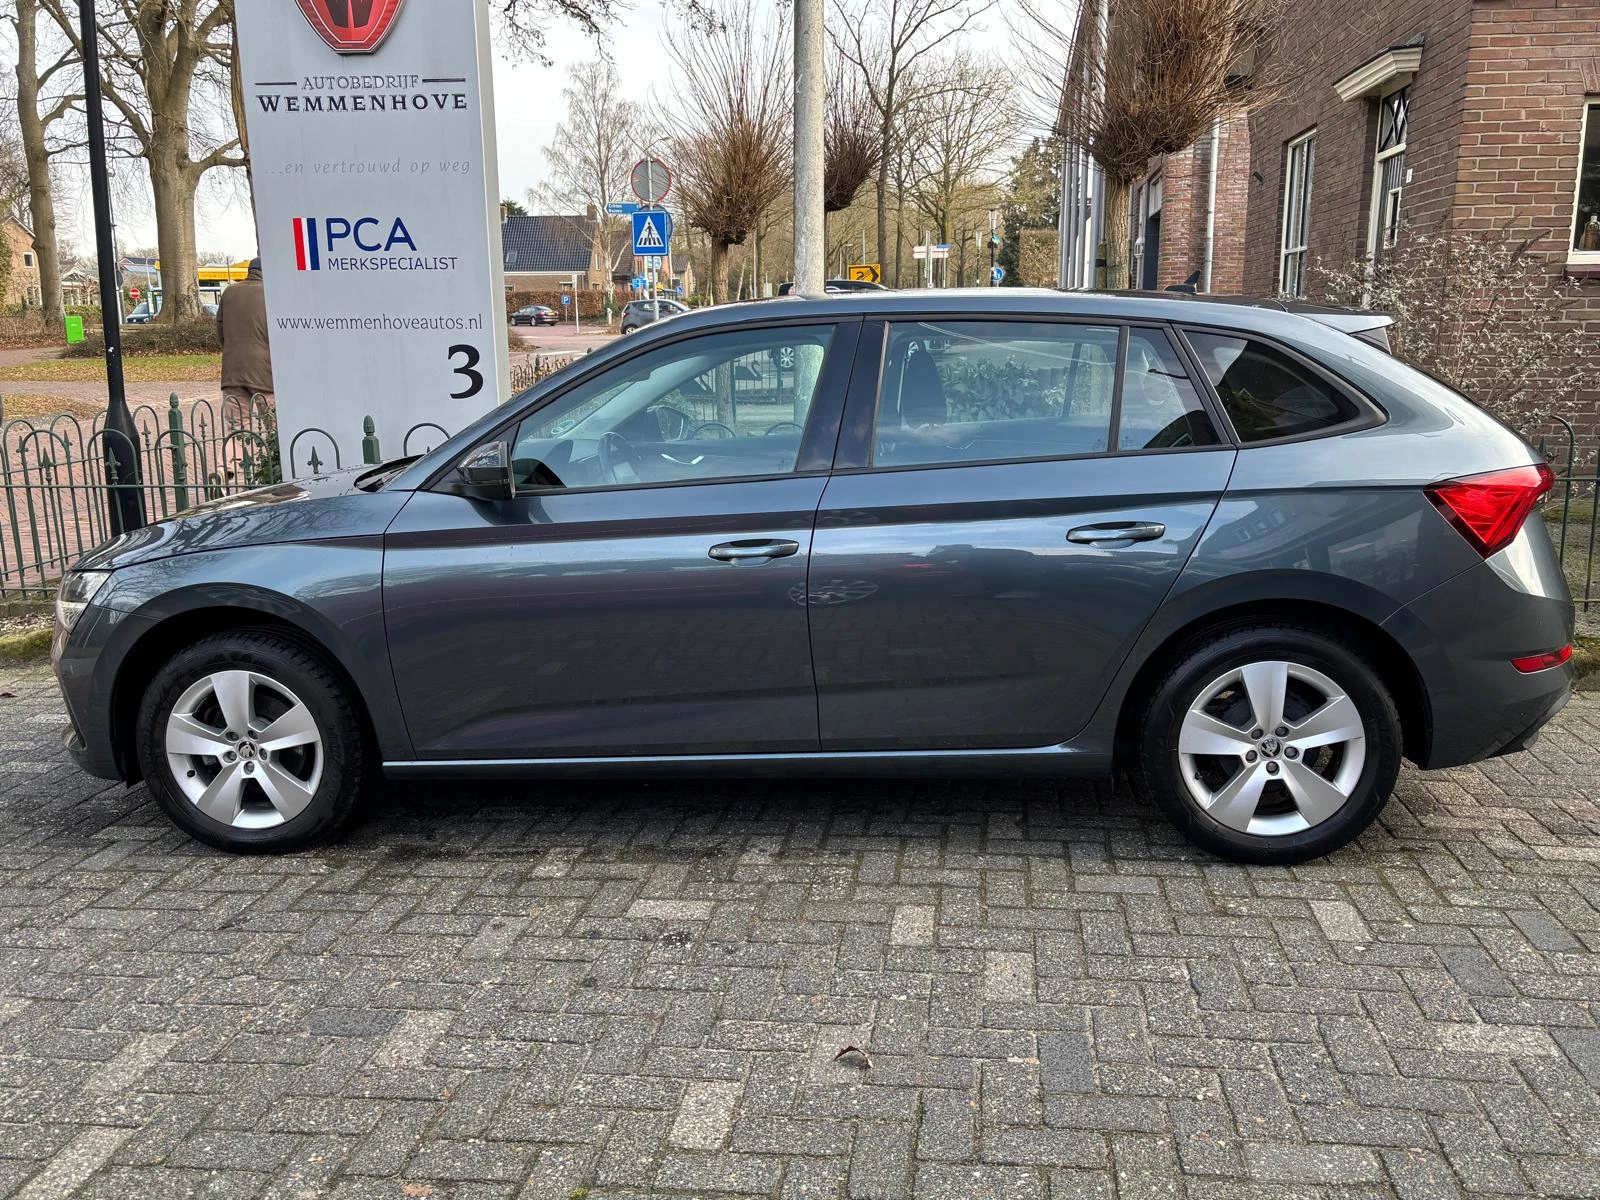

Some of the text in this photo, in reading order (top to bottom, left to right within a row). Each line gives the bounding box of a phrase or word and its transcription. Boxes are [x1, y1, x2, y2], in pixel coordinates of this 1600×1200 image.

[301, 75, 419, 90] AUTOBEDRIJF
[257, 93, 467, 112] WEMMENHOVE
[314, 158, 401, 175] vertrouwd
[410, 159, 430, 175] op
[439, 159, 471, 175] weg
[326, 217, 417, 252] PCA
[328, 256, 458, 271] MERKSPECIALIST
[276, 313, 484, 331] www.wemmenhoveautos.nl
[447, 344, 484, 400] 3
